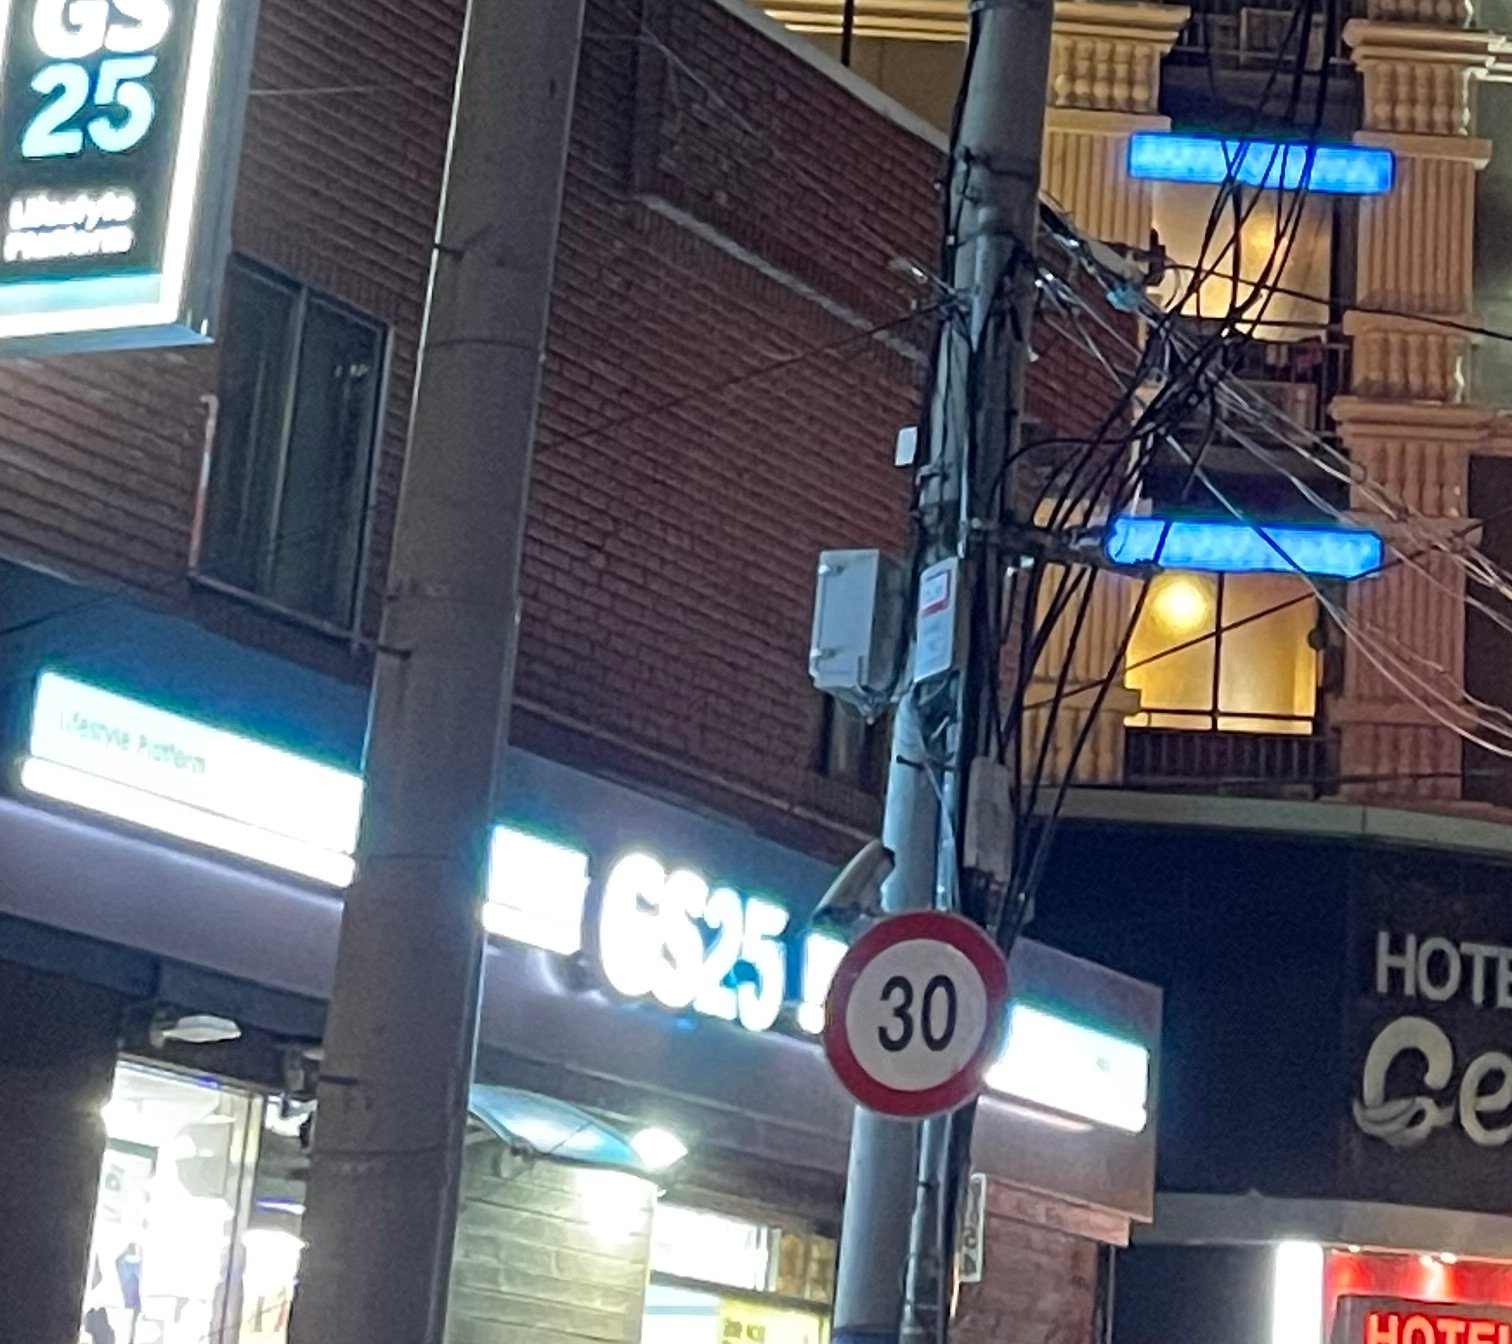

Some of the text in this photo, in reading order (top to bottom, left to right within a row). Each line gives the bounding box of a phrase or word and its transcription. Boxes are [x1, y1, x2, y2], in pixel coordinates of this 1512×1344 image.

[21, 54, 157, 158] 25
[601, 851, 788, 1032] GS25
[878, 974, 957, 1052] 30
